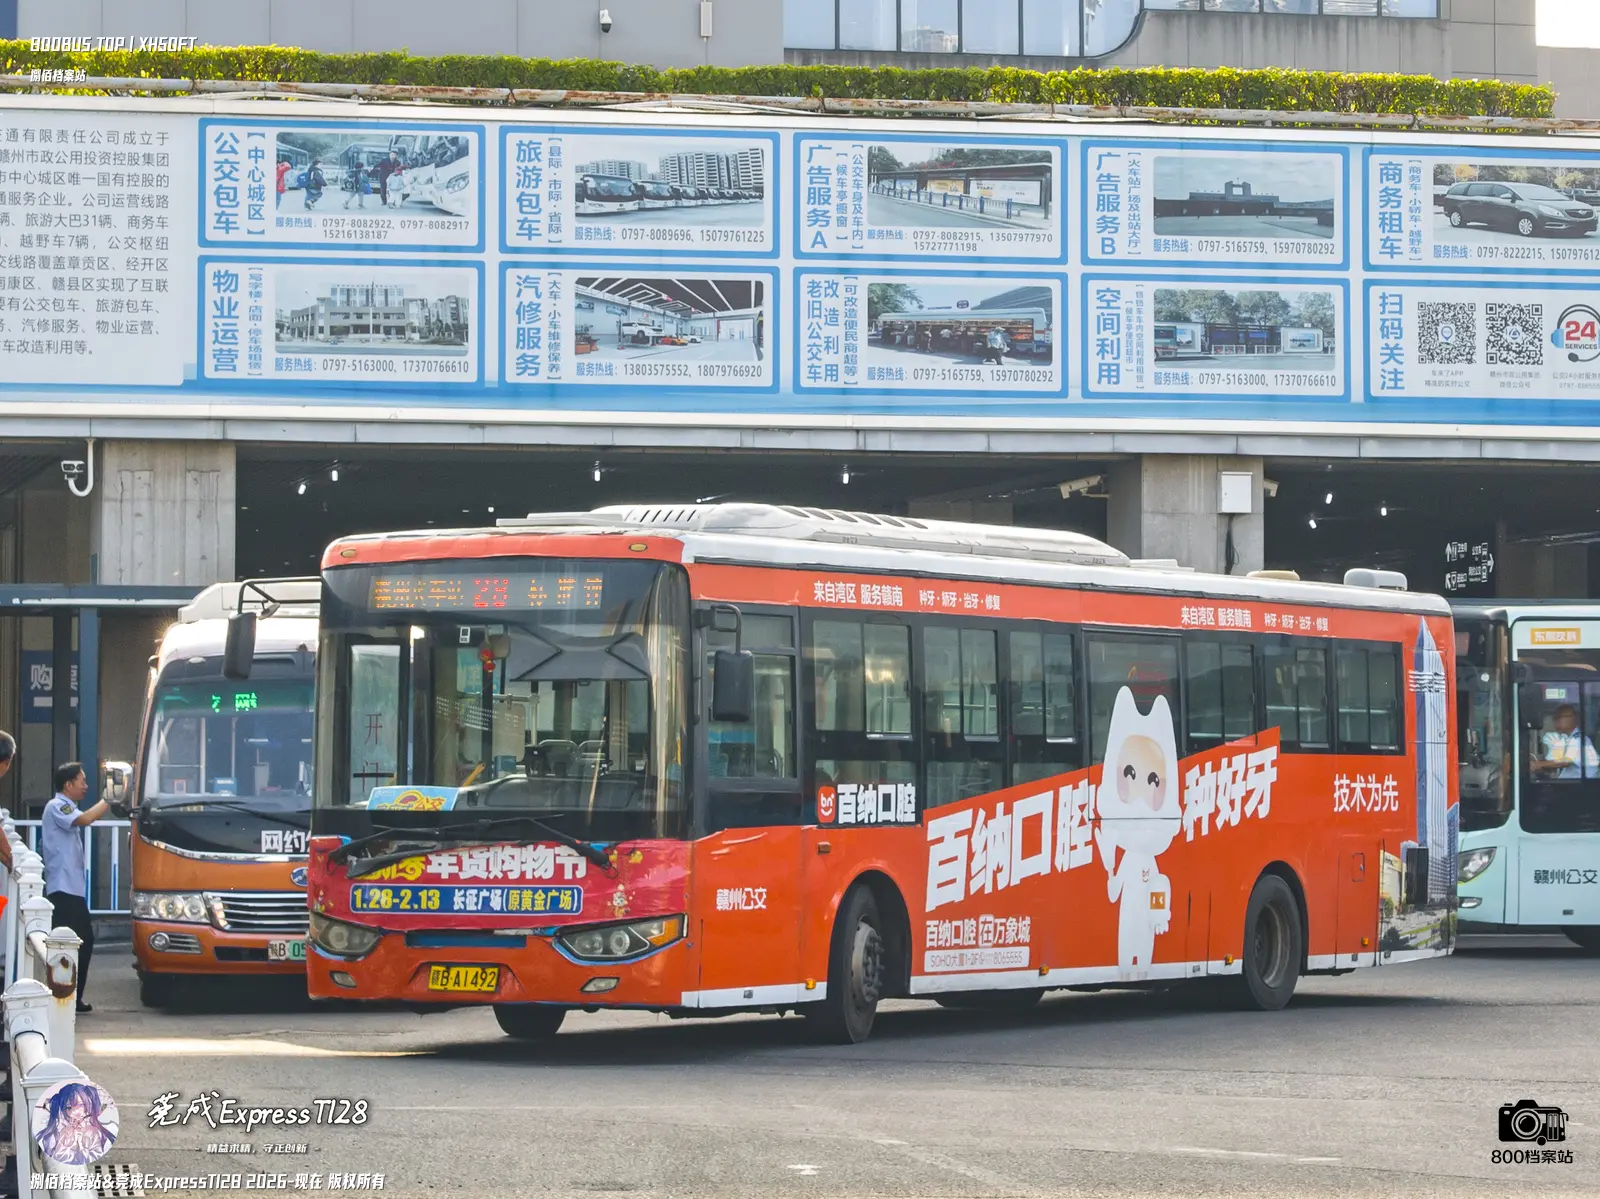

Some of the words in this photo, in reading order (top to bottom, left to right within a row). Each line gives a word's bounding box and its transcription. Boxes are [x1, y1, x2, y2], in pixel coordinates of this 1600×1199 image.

[213, 132, 240, 234] 公交包车
[516, 140, 542, 241] 旅游包车
[806, 144, 832, 249] 广告服务A
[1096, 152, 1121, 255] 广告服务B
[1379, 161, 1403, 259] 商务租车
[323, 230, 388, 240] 15216138187
[400, 220, 470, 231] 0797-8082917
[700, 229, 765, 243] 15079761225
[0, 233, 169, 250] 、越野车7辆，公交枢纽
[914, 241, 977, 252] 15727771198
[989, 232, 1053, 243] 13507977970
[1273, 242, 1335, 255] 15970780292
[212, 269, 239, 373] 物业运营
[516, 274, 542, 377] 汽修服务
[806, 280, 822, 383] 老旧公交车
[823, 280, 839, 383] 改造利用
[1565, 321, 1596, 341] 24
[0, 339, 93, 355] 车改造利用等。
[1096, 287, 1121, 385] 空间利用
[1379, 292, 1405, 390] 扫码关注
[403, 360, 469, 373] 17370766610
[697, 364, 762, 377] 18079766920
[990, 369, 1053, 383] 15970780292
[1274, 374, 1336, 387] 17370766610
[814, 581, 856, 603] 来自湾区
[861, 584, 903, 606] 服务赣南
[1181, 606, 1215, 625] 来自湾区
[1218, 608, 1251, 627] 服务赣南
[837, 782, 916, 824] 百纳口腔
[1333, 773, 1399, 813] 技术为先
[925, 779, 1096, 912] 百纳口腔
[1182, 746, 1278, 843] 种好牙
[261, 830, 311, 853] 网约
[1534, 868, 1598, 885] 赣州公交
[353, 889, 440, 910] 1.28-2.13
[716, 887, 767, 911] 赣州公交
